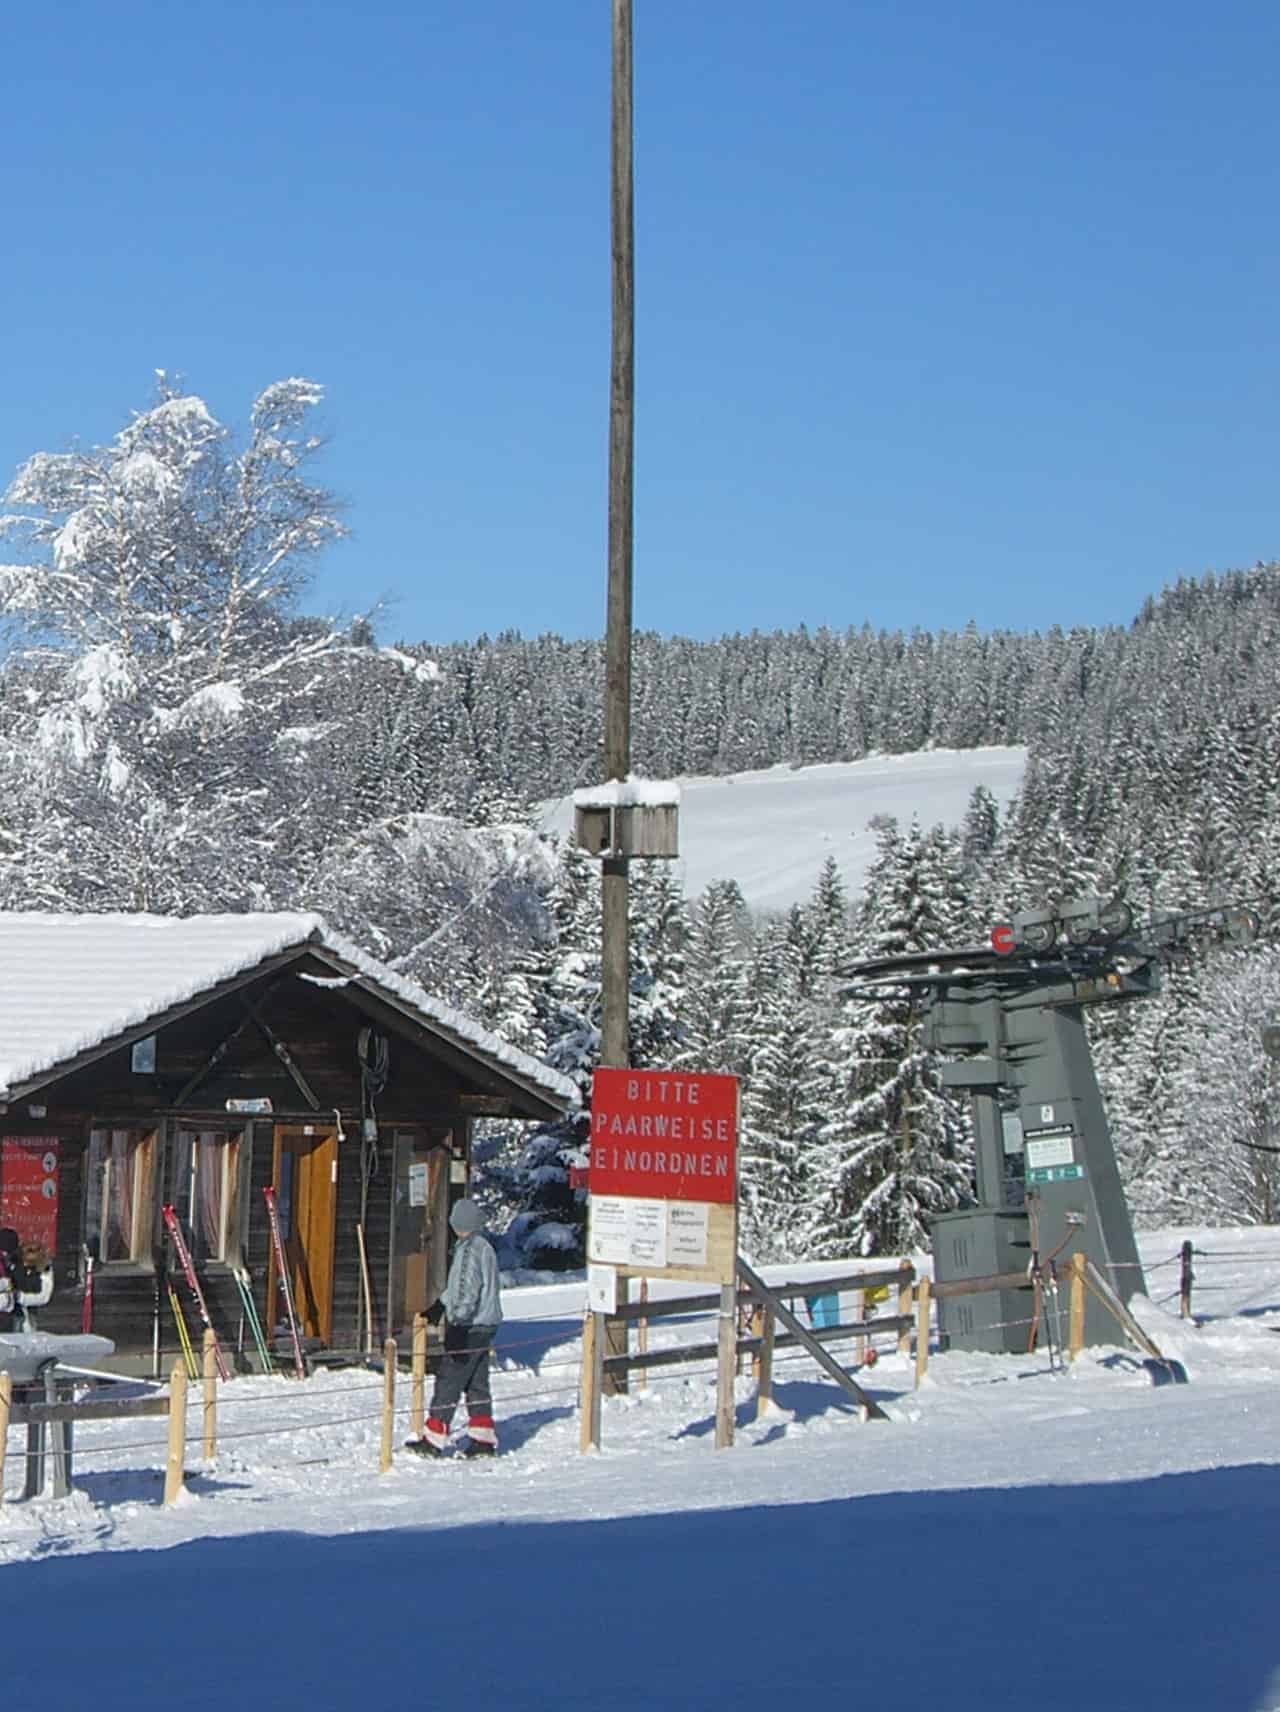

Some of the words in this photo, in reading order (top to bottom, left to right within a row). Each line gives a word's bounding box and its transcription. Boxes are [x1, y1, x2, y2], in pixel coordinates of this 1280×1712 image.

[627, 1079, 700, 1105] BITTE
[595, 1112, 729, 1142] PAARWEISE
[594, 1147, 728, 1177] EINORDNEN
